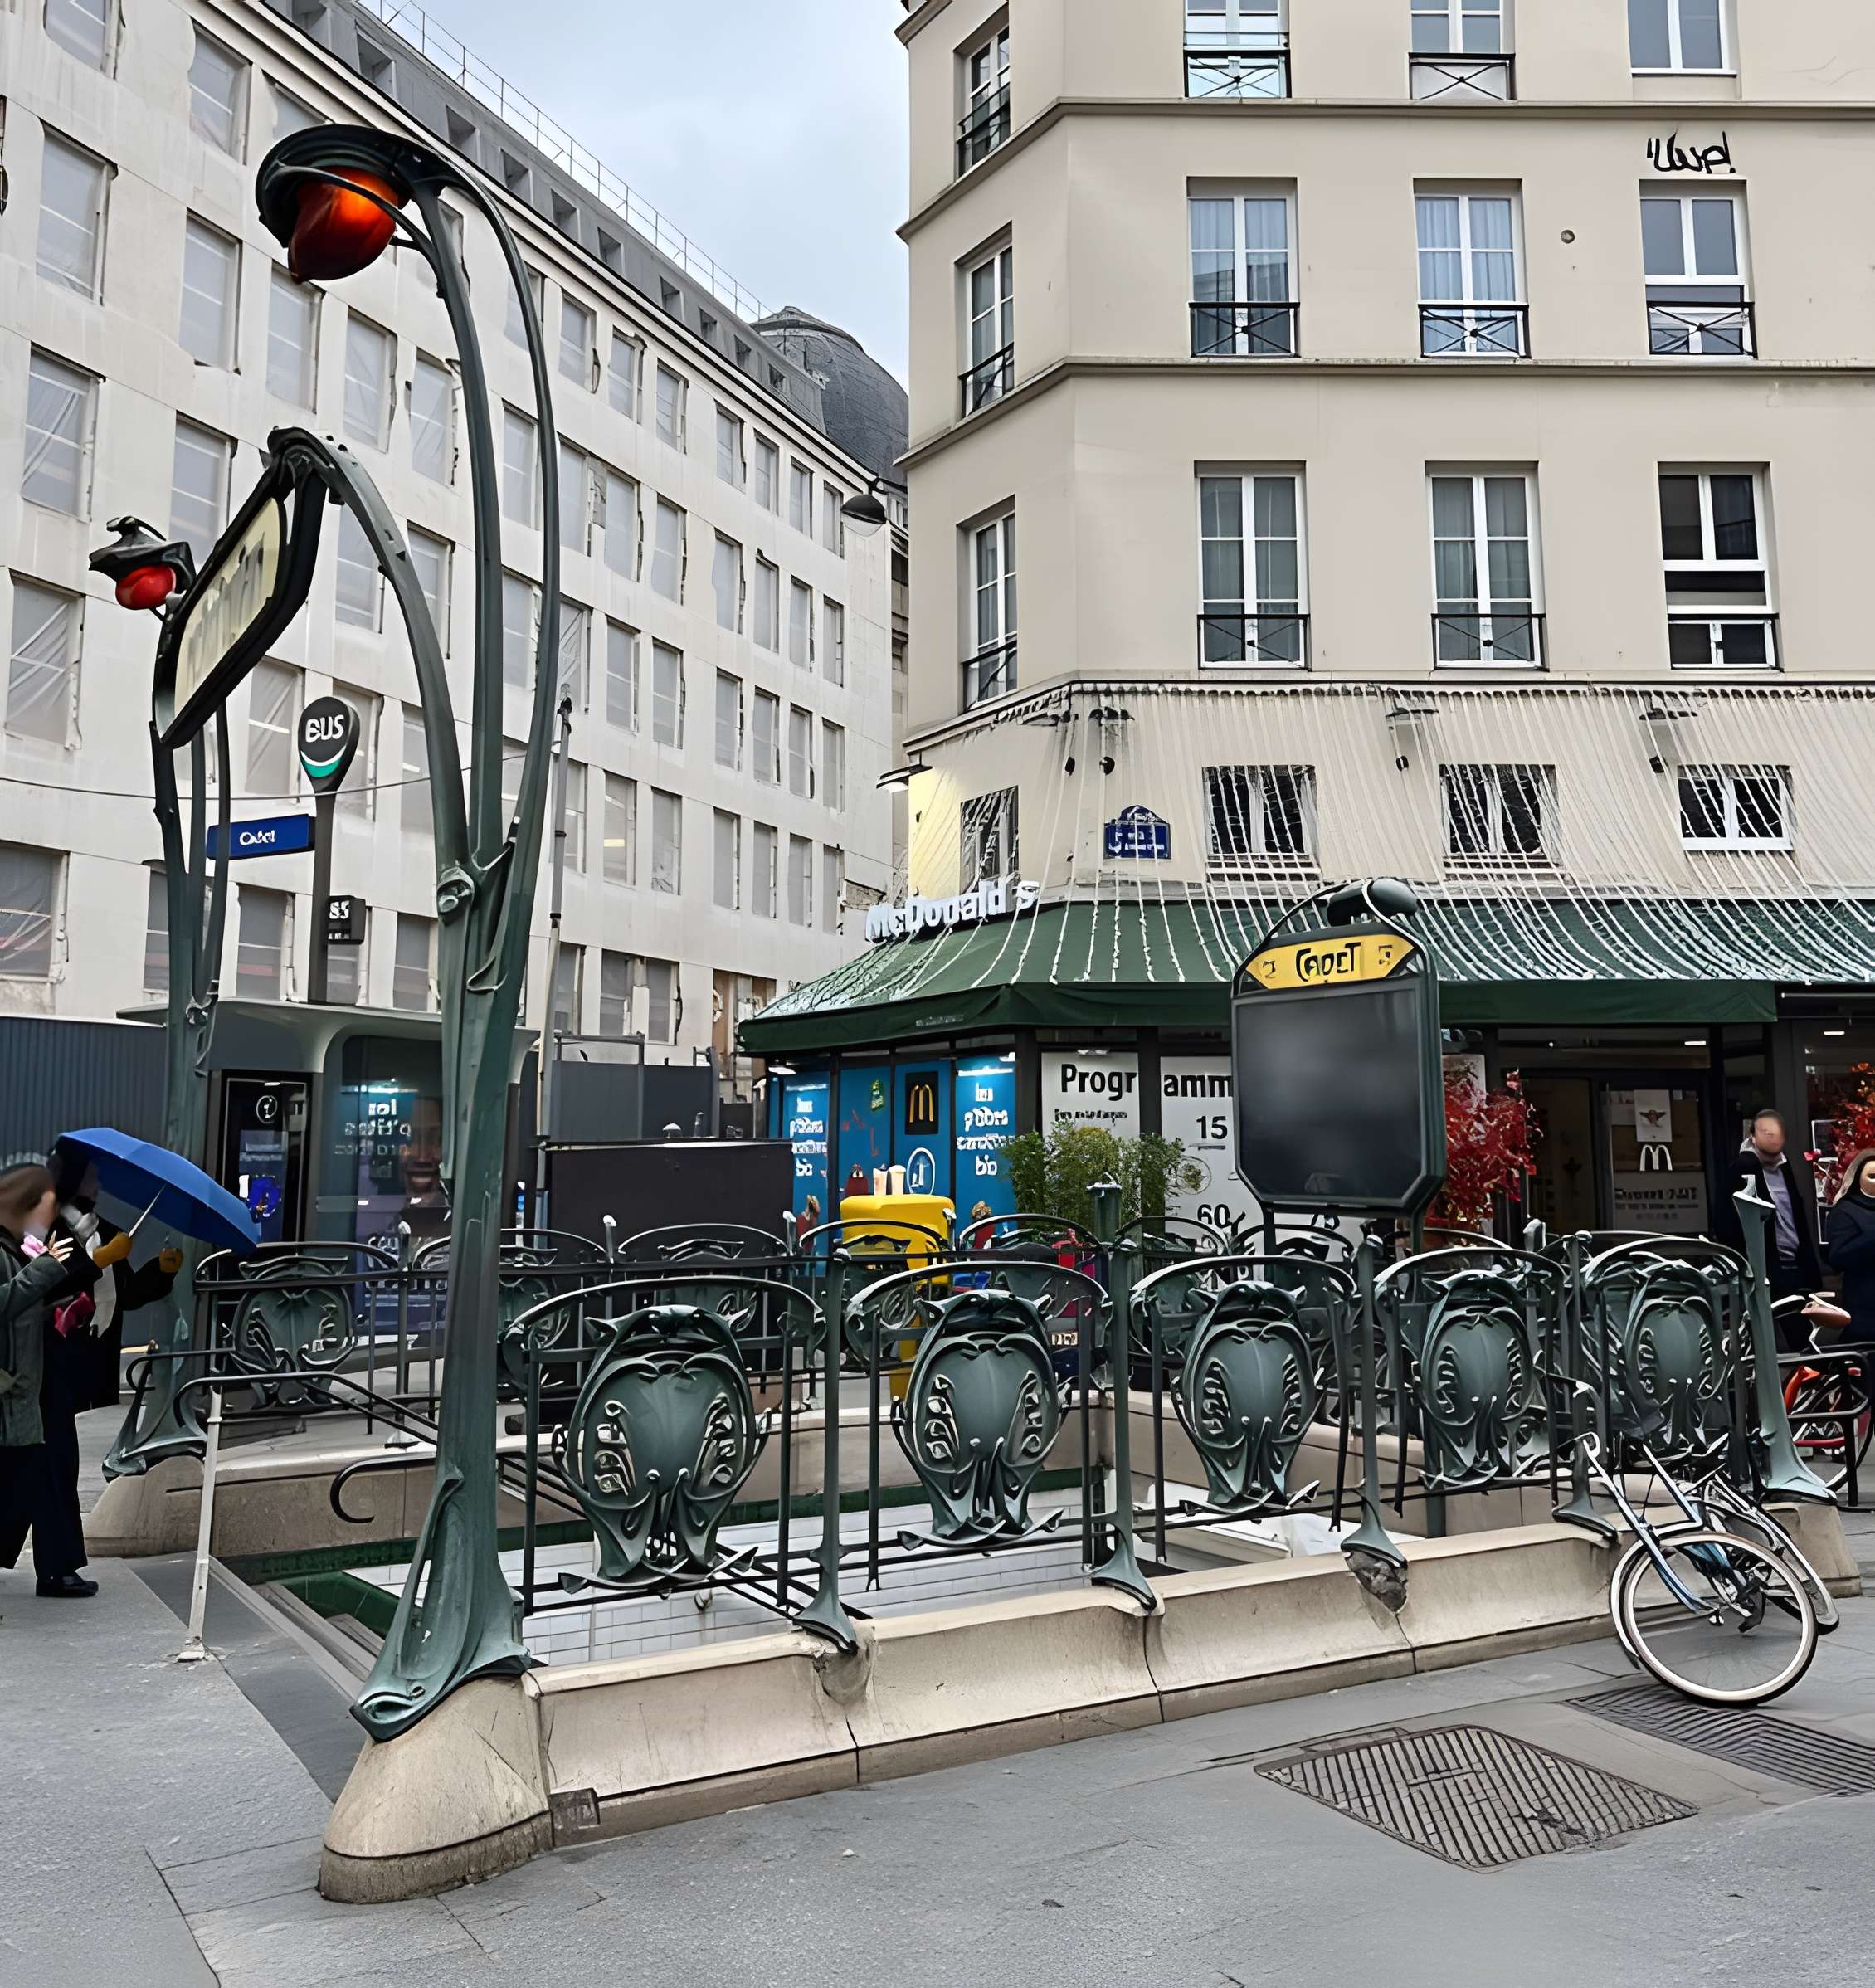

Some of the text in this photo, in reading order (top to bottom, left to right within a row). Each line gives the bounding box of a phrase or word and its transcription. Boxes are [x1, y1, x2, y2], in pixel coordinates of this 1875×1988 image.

[305, 714, 345, 743] BUS
[1061, 1063, 1137, 1101] Progr
[1196, 1115, 1228, 1140] 15
